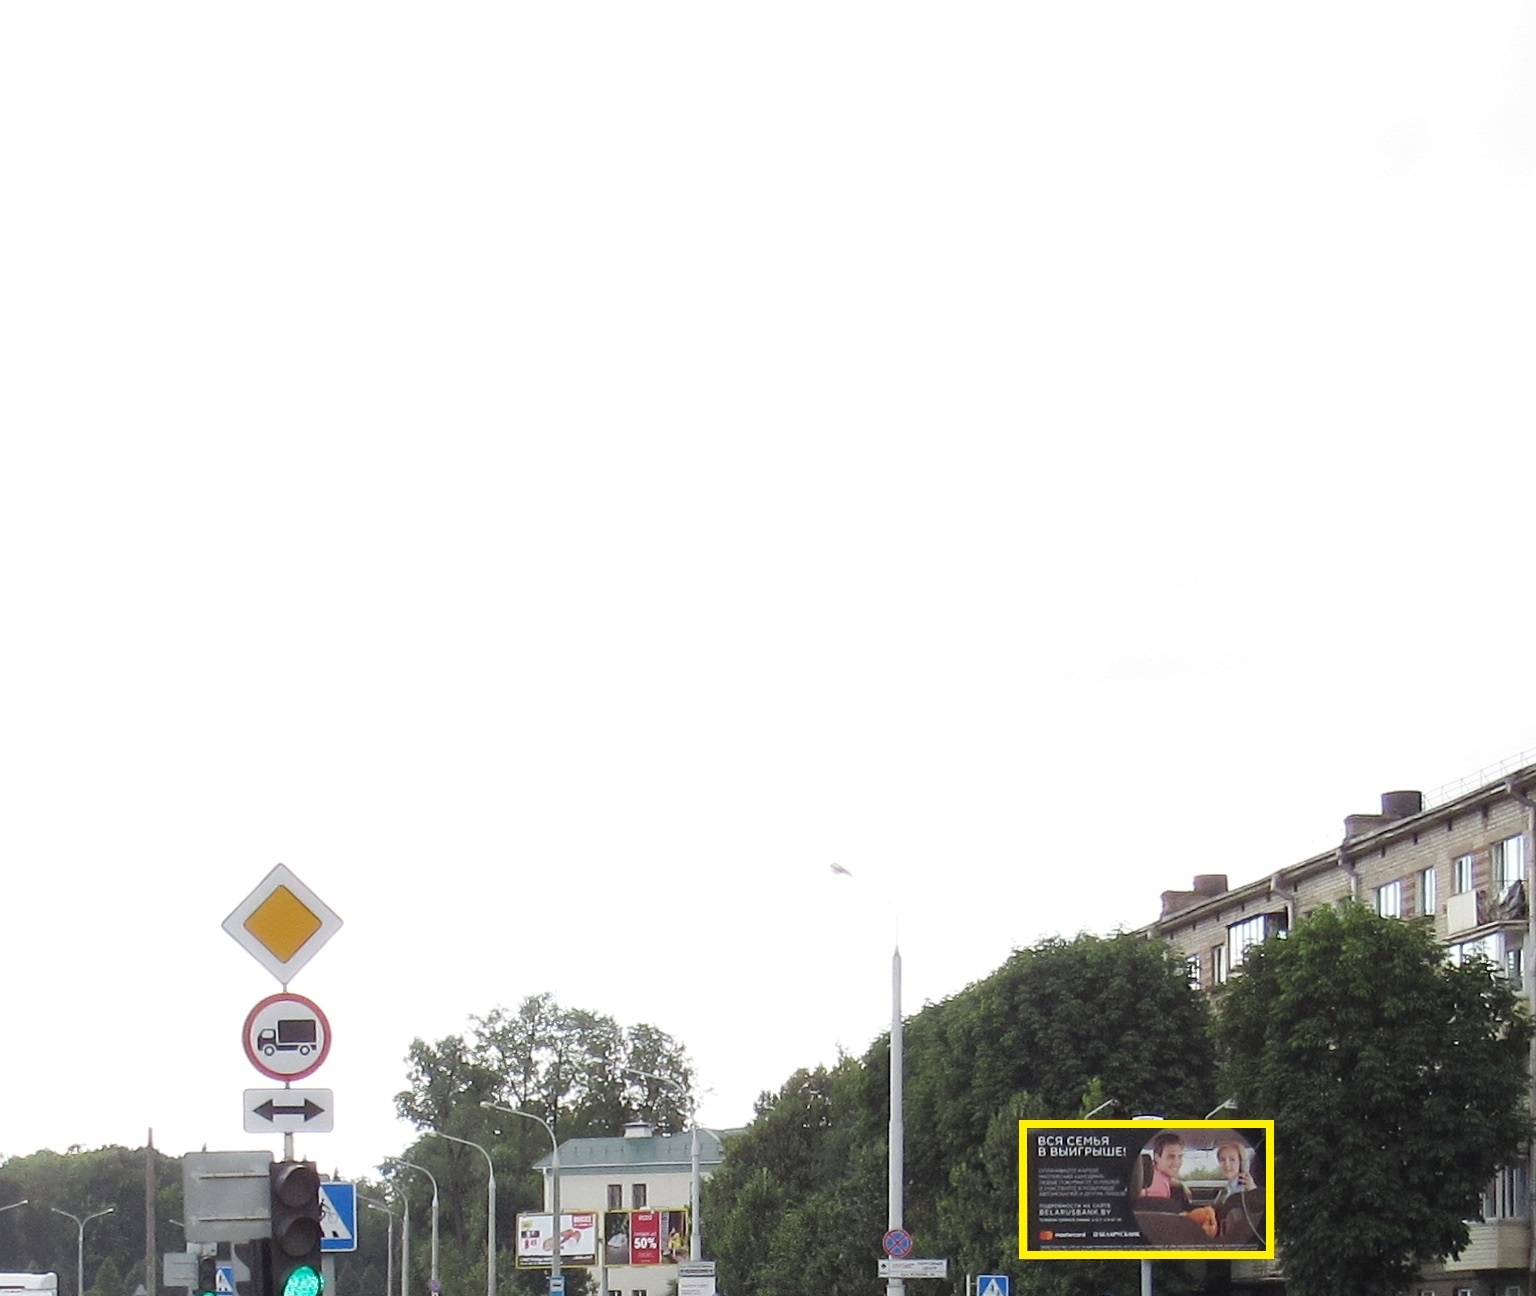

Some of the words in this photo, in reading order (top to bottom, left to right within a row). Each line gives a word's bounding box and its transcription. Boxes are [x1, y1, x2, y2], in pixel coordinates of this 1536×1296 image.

[1037, 1135, 1064, 1147] ВСЯ
[1066, 1135, 1110, 1147] СЕМЬЯ
[1038, 1147, 1047, 1157] В
[1050, 1146, 1127, 1157] ВЫИГРЫШЕ!
[634, 1237, 657, 1250] 50%
